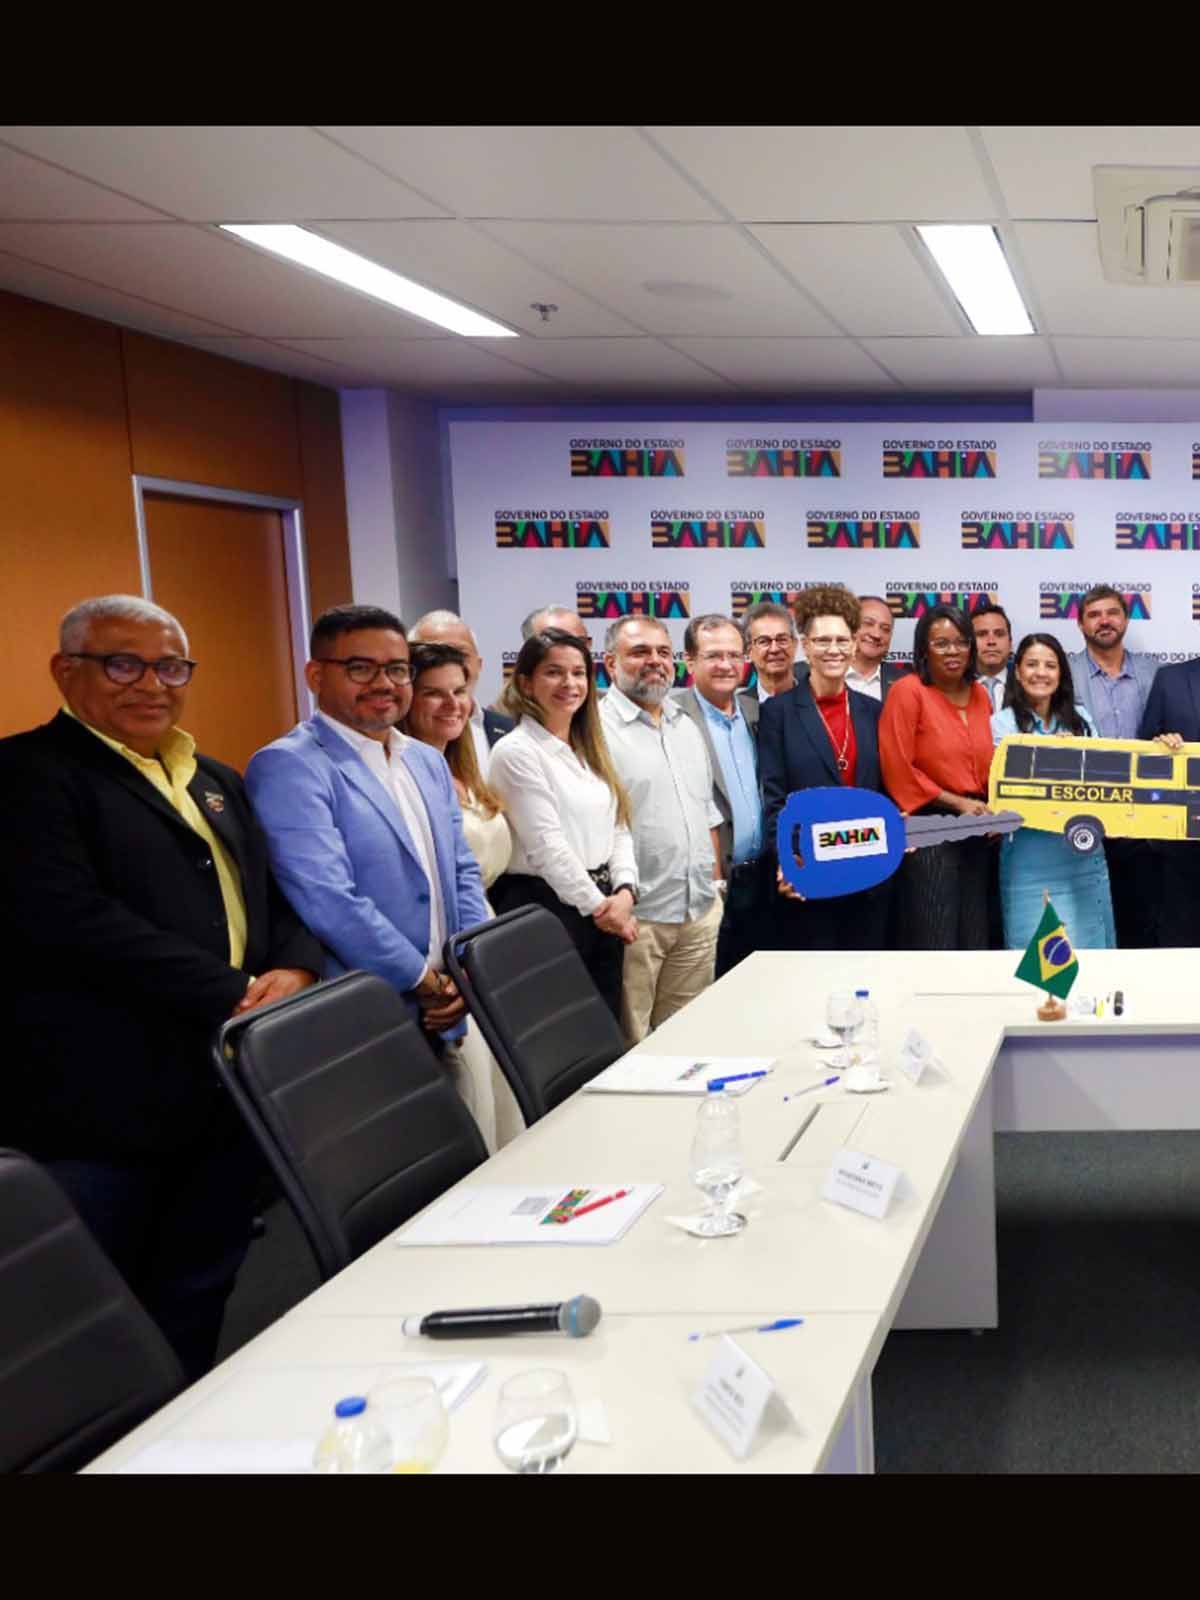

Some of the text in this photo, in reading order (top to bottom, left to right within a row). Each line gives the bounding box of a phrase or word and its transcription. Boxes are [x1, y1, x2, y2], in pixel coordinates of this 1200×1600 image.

[570, 438, 685, 449] GOVERNO DO ESTADO
[726, 439, 842, 450] GOVERNO DO ESTADO
[882, 440, 997, 450] GOVERNO DO ESTADO
[1038, 441, 1152, 452] GOVERNO DO ESTADO
[571, 450, 684, 477] BAHIA
[728, 450, 841, 478] BAHIA
[884, 451, 996, 478] BAHIA
[1039, 452, 1150, 480] BAHIA
[494, 510, 609, 520] GOVERNO DO ESTADO
[650, 510, 765, 520] GOVERNO DO ESTADO
[806, 510, 920, 521] GOVERNO DO ESTADO
[960, 511, 1074, 522] GOVERNO DO ESTADO
[1116, 512, 1168, 522] GOVERNO
[1170, 512, 1185, 522] DO
[496, 521, 610, 548] BAHIA
[651, 521, 765, 548] BAHIA
[807, 521, 920, 548] BAHIA
[962, 522, 1074, 549] BAHIA
[576, 582, 690, 592] GOVERNO DO ESTADO
[730, 582, 784, 592] GOVERNO
[786, 582, 801, 592] DO
[886, 582, 999, 592] GOVERNO DO ESTADO
[1040, 582, 1092, 592] GOVERNO
[1112, 582, 1152, 592] ESTADO
[577, 592, 690, 618] BAHIA
[1170, 652, 1186, 662] DO
[1051, 786, 1133, 802] ESCOLAR
[819, 827, 881, 848] BAHIA
